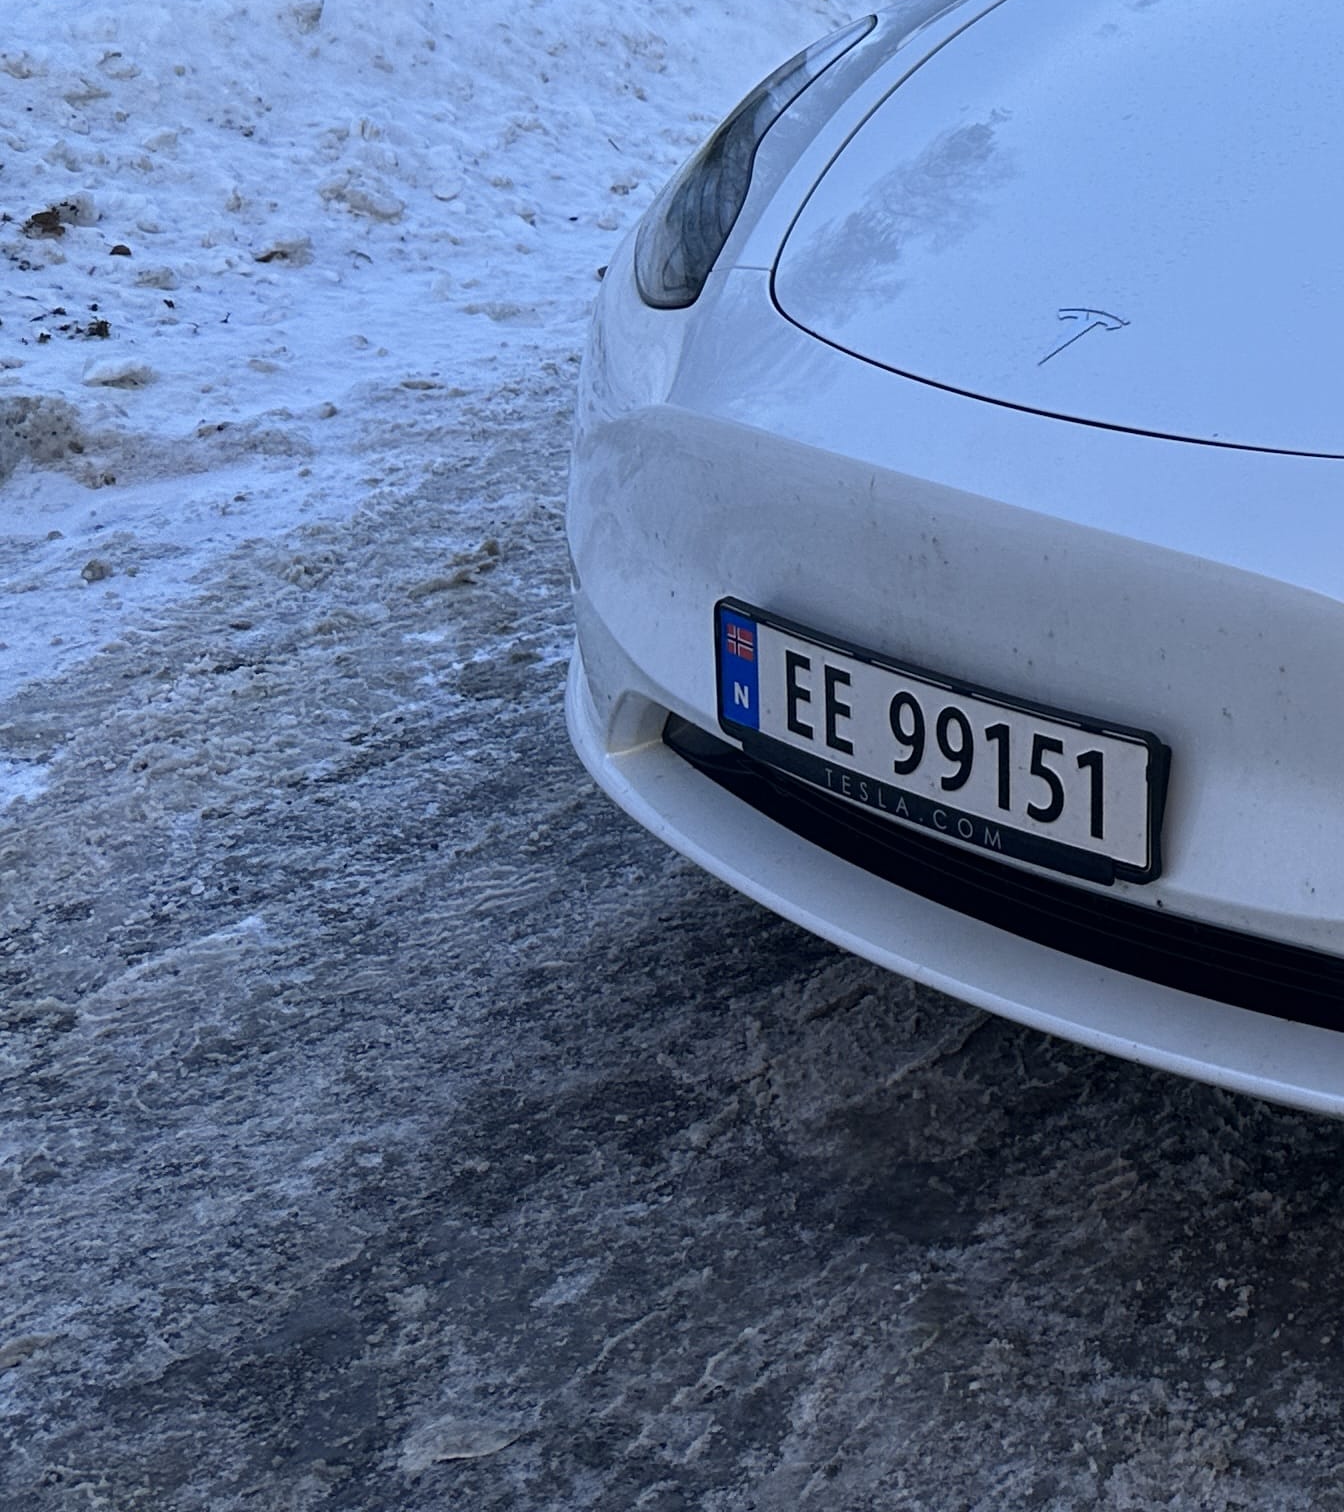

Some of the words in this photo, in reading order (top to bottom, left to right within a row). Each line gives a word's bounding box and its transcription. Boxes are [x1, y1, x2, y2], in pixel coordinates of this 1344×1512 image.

[734, 682, 750, 710] N
[785, 649, 854, 756] EE
[889, 691, 1104, 840] 99151
[824, 767, 1003, 850] TESLA.COM
